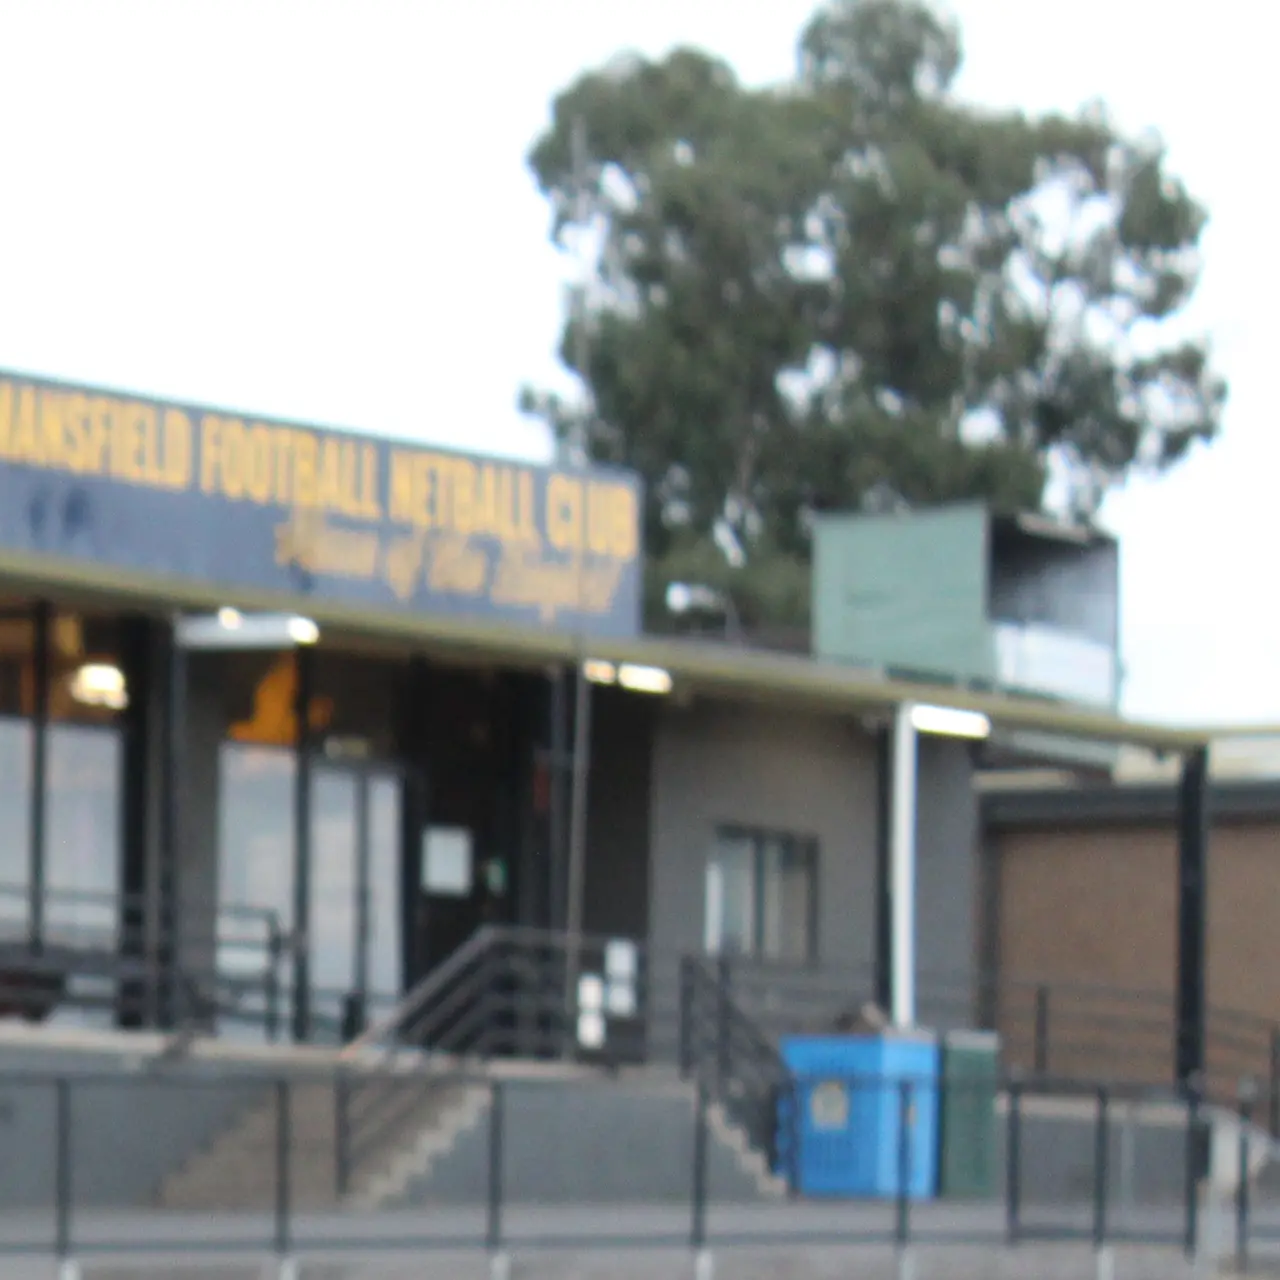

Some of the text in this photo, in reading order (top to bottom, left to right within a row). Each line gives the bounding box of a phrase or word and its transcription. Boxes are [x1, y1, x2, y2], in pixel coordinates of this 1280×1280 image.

[200, 413, 380, 518] FOOTBALL
[388, 449, 541, 542] NETBALL
[545, 472, 636, 560] CLUB
